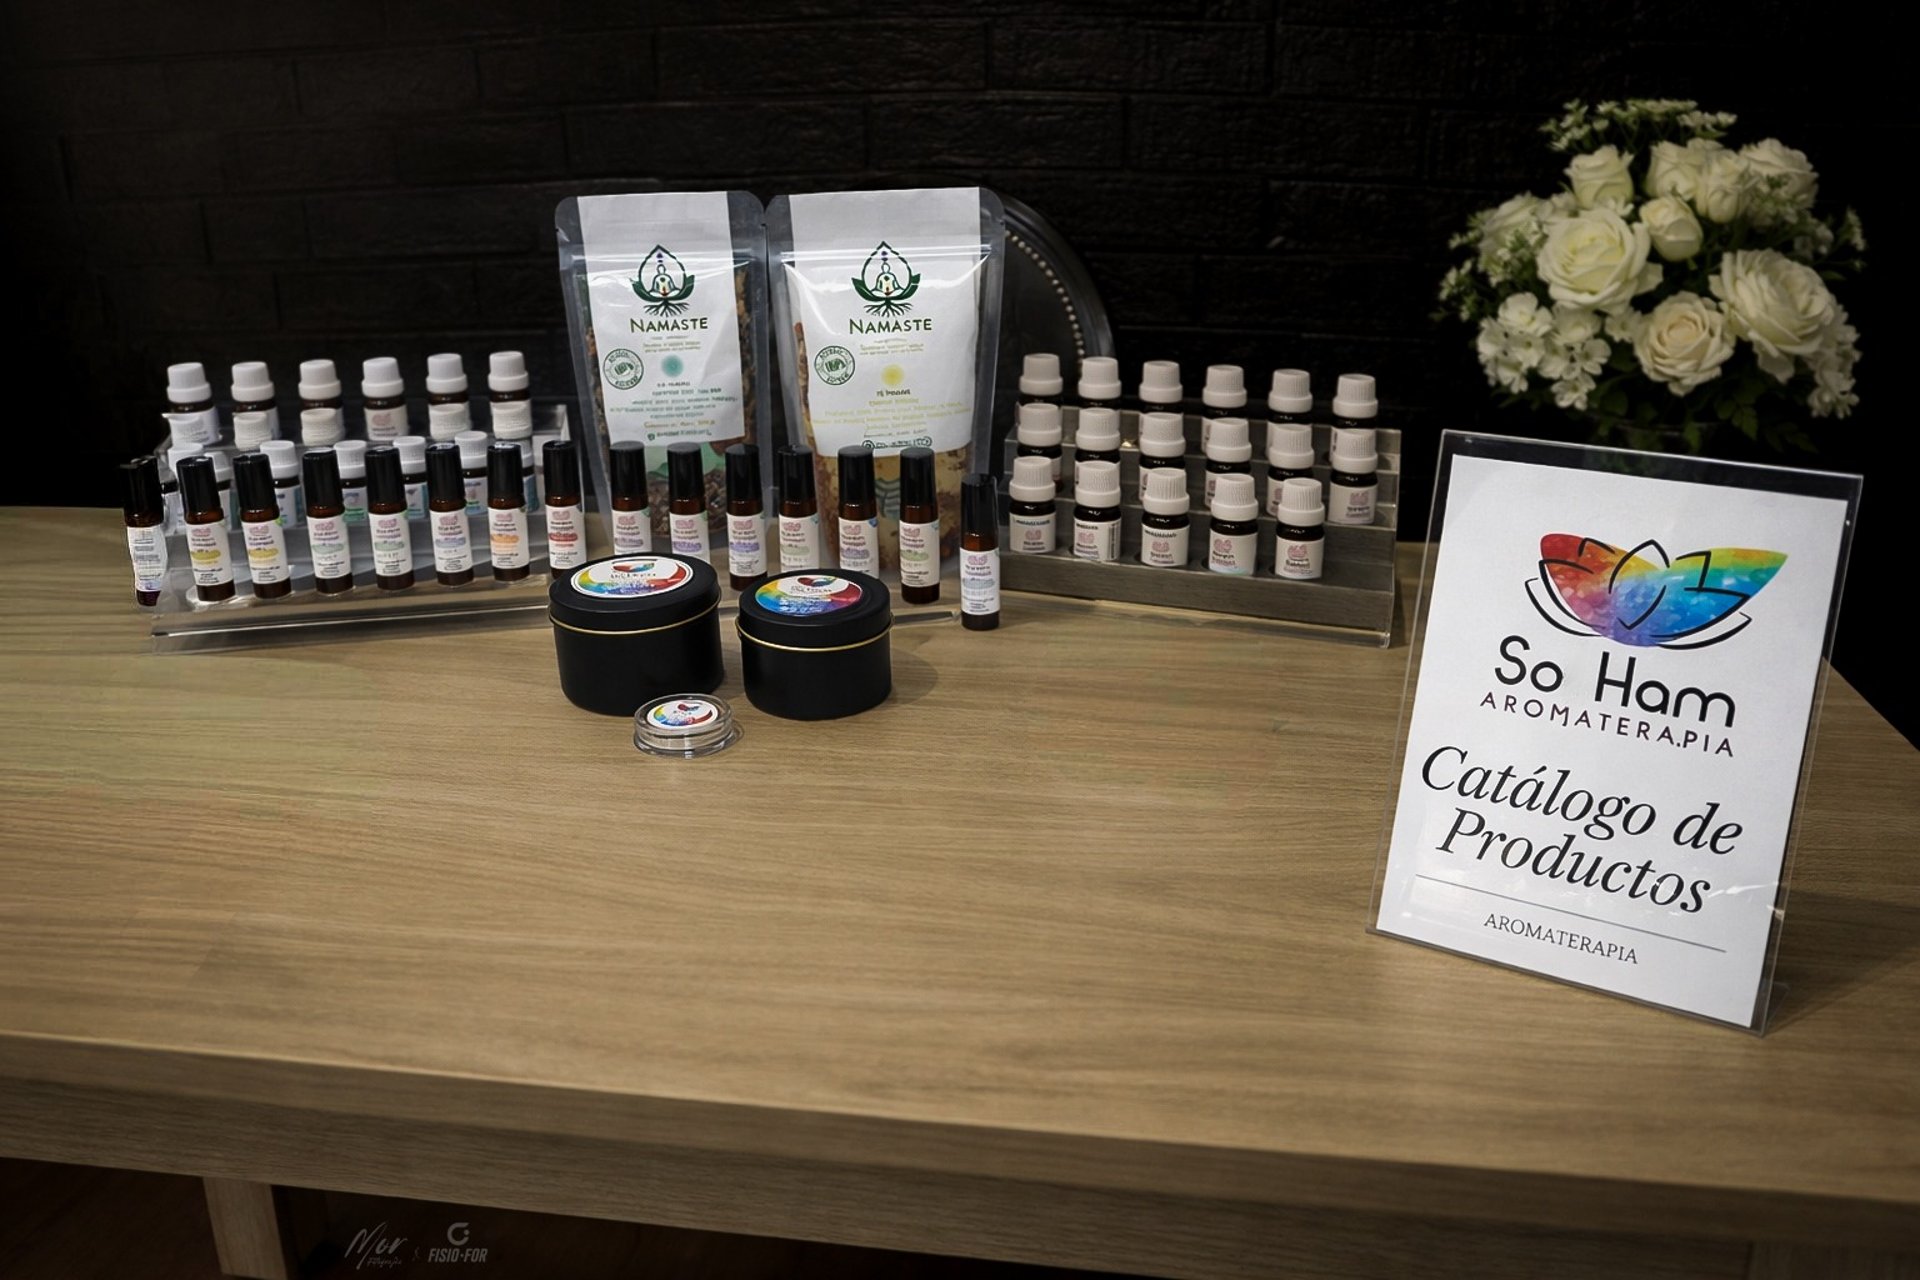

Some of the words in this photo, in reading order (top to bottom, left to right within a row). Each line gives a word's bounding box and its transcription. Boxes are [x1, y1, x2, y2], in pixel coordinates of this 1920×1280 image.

[630, 317, 709, 334] NAMASTE
[849, 318, 933, 335] NAMASTE
[1494, 635, 1564, 693] So
[1594, 651, 1736, 728] Ham
[1421, 745, 1657, 841] Catálogo
[1672, 802, 1743, 855] de
[1435, 807, 1711, 913] Productos
[1483, 913, 1639, 964] AROMATERAPIA
